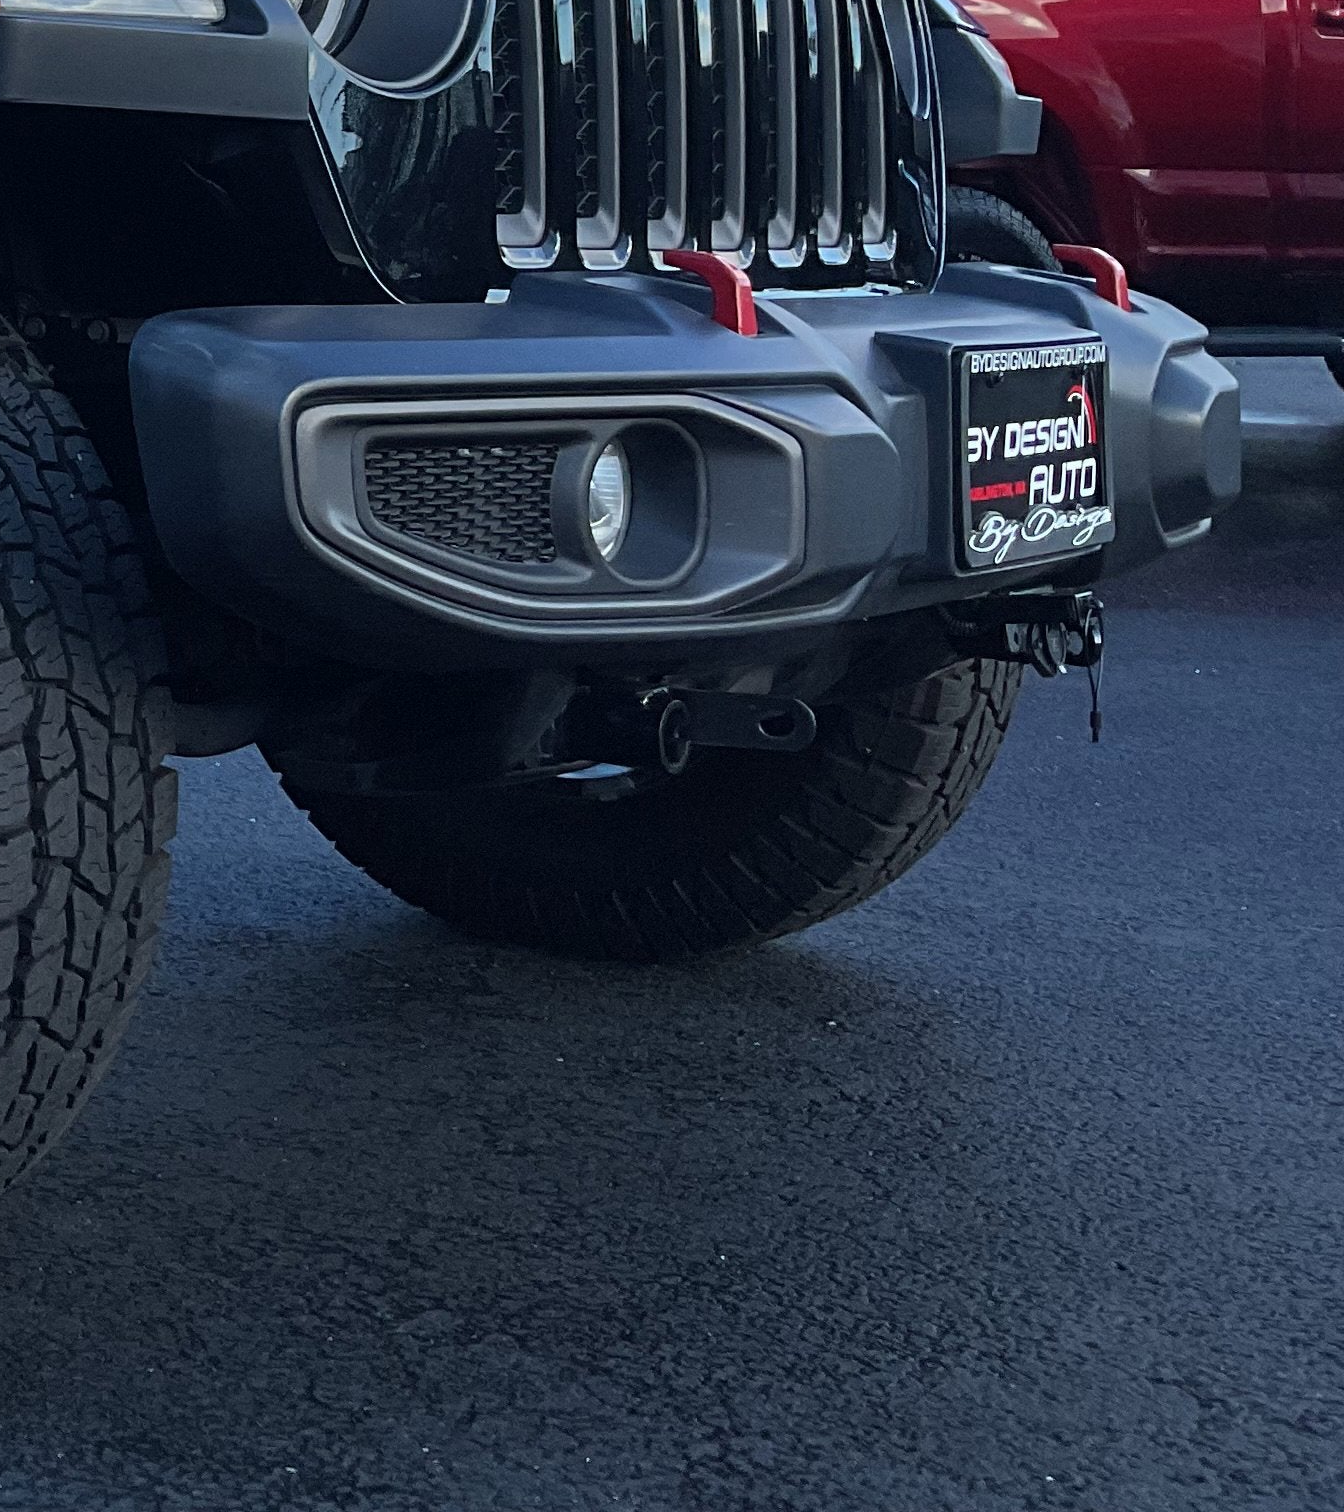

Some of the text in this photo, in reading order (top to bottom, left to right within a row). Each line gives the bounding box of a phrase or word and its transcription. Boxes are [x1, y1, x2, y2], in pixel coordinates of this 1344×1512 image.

[970, 345, 1106, 373] BYDESIGNAUTOGROUP.COM
[1004, 416, 1085, 459] DESIGN
[1029, 458, 1096, 506] AUTO
[969, 507, 1112, 564] By Design
